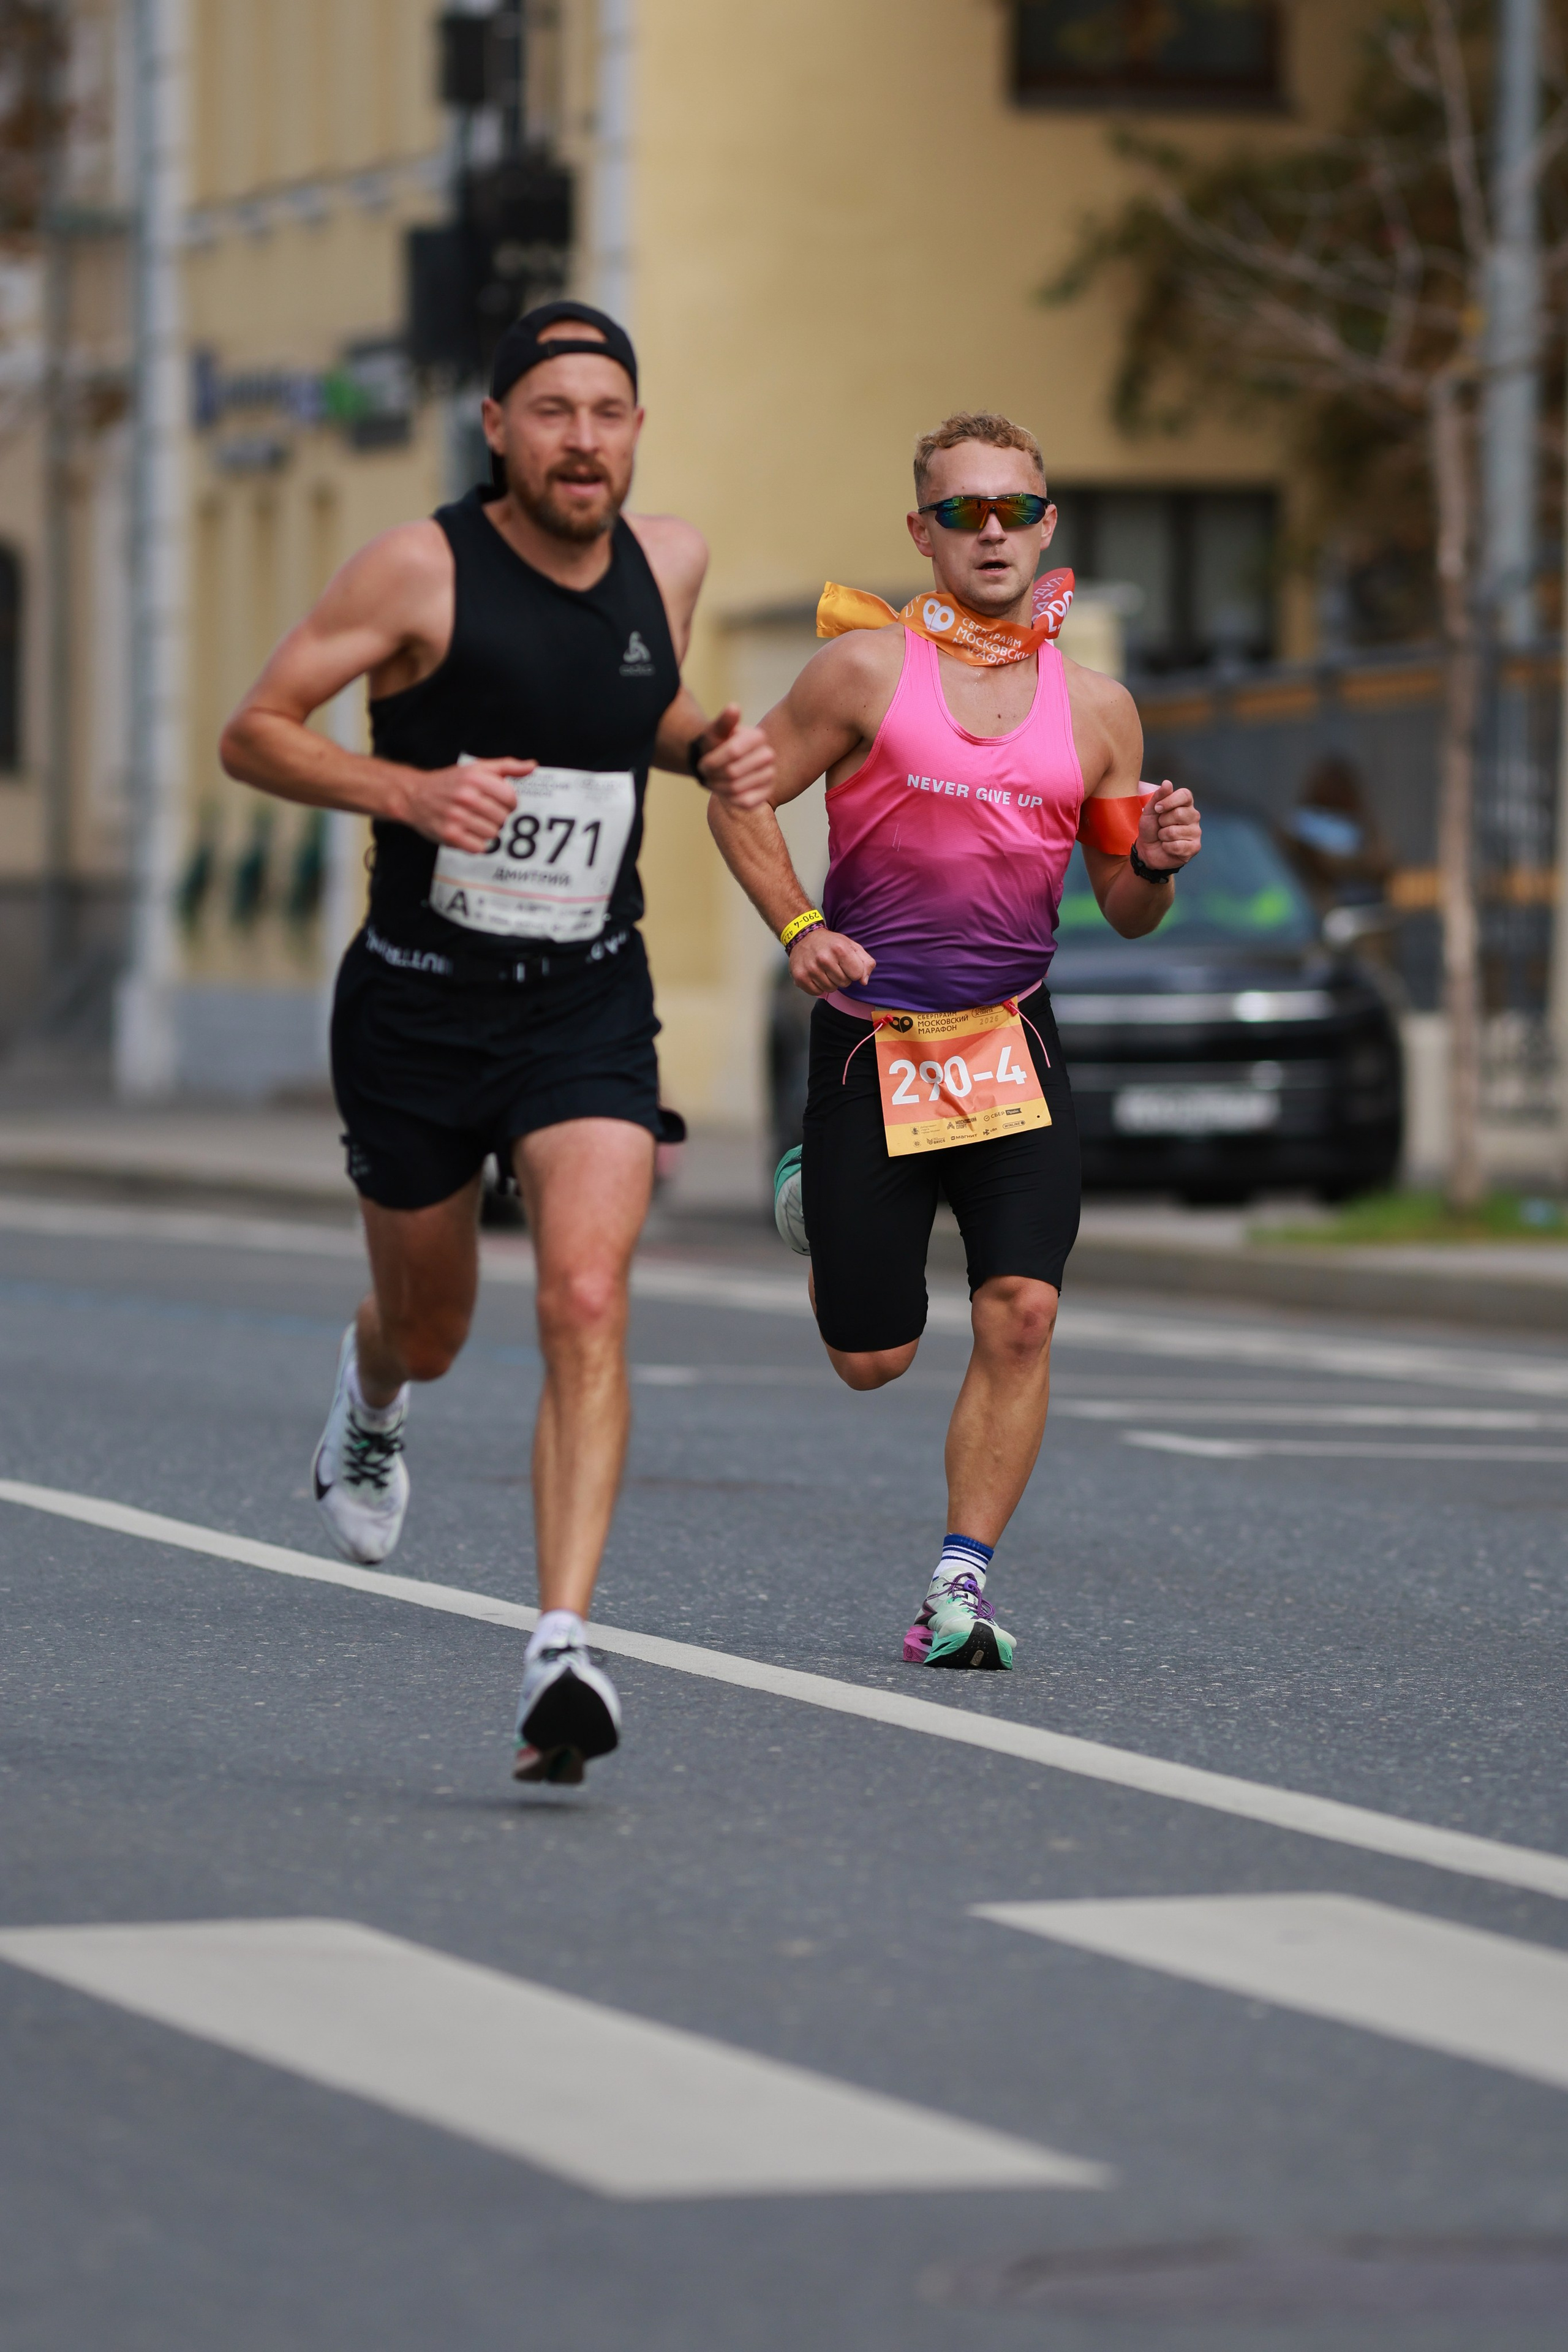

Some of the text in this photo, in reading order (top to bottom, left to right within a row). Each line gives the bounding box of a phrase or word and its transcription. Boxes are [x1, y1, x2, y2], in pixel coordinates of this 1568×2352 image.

[952, 637, 1009, 665] МАРАФО
[956, 626, 1032, 660] МОСКОВСКИ
[907, 774, 1042, 808] NEVER GIVE UP
[483, 814, 602, 869] 871
[793, 912, 820, 928] 290-4
[918, 1014, 968, 1027] МОСКОВСКИЙ
[918, 1025, 957, 1035] МАРАФОН
[888, 1046, 1028, 1106] 290-4
